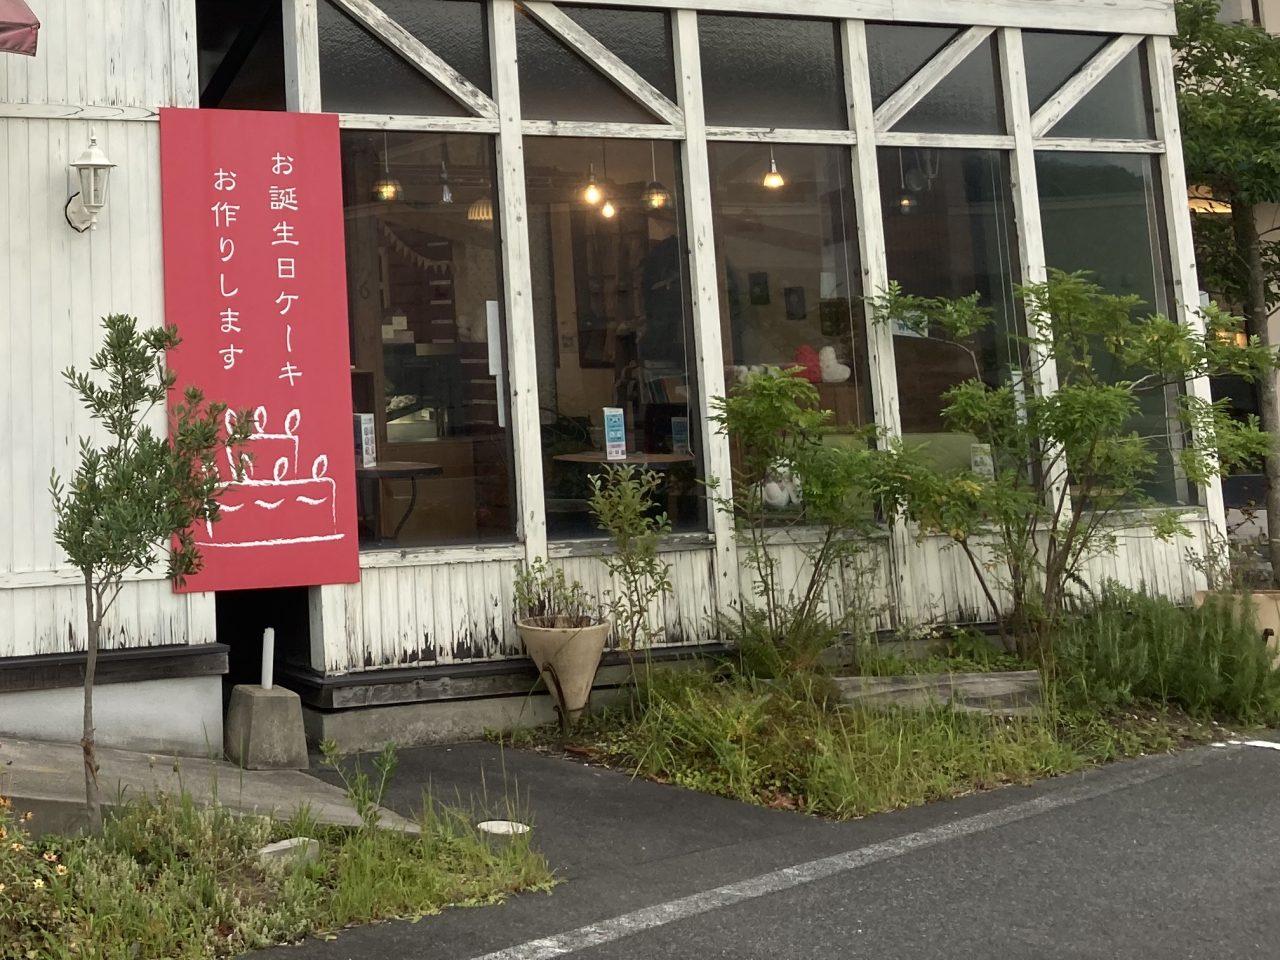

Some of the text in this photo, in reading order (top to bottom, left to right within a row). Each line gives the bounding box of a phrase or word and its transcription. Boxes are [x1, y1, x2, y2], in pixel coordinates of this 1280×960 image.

[210, 167, 244, 371] お作りします
[269, 151, 303, 388] お誕生日ケーキ
